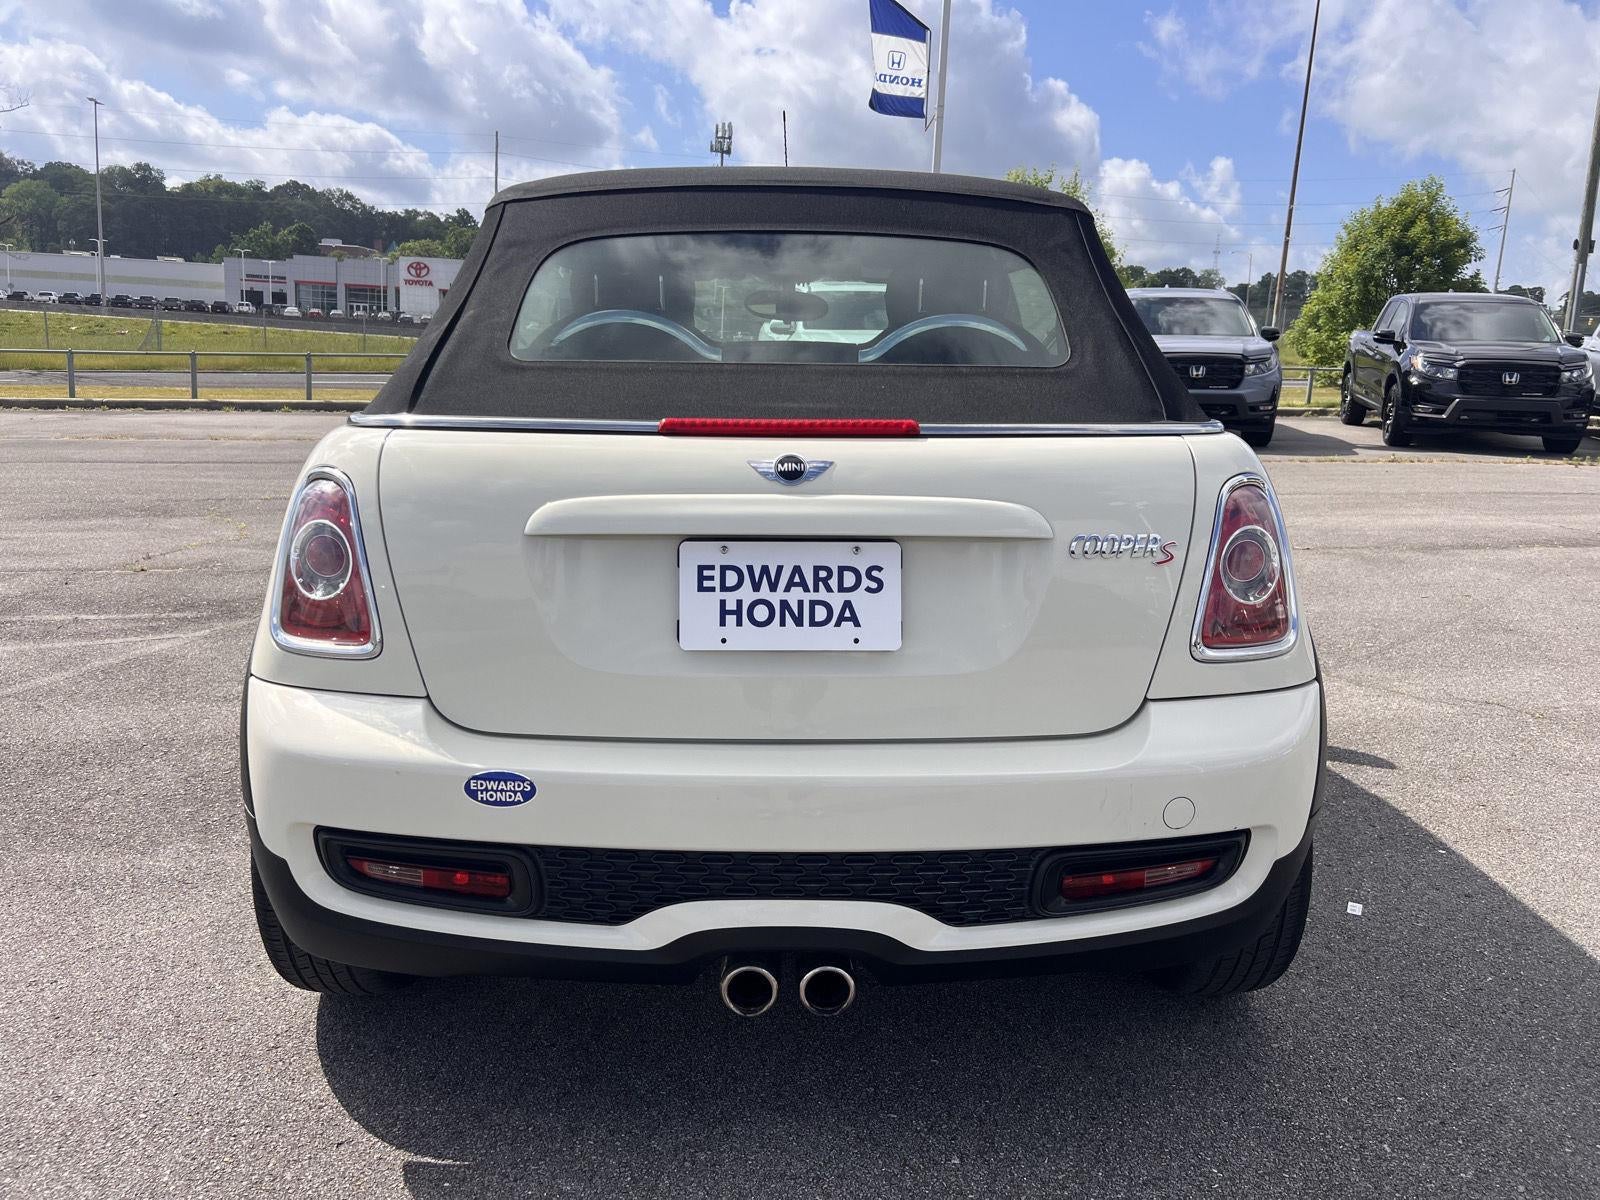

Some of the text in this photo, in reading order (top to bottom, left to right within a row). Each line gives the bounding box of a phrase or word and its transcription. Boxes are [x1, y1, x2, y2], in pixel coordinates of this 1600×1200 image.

[403, 279, 433, 287] TOYOTA
[777, 462, 805, 472] MINI
[1069, 533, 1178, 566] COOPER S
[696, 564, 885, 594] EDWARDS
[719, 598, 862, 628] HONDA
[470, 779, 532, 792] EDWARDS
[477, 790, 524, 802] HONDA
